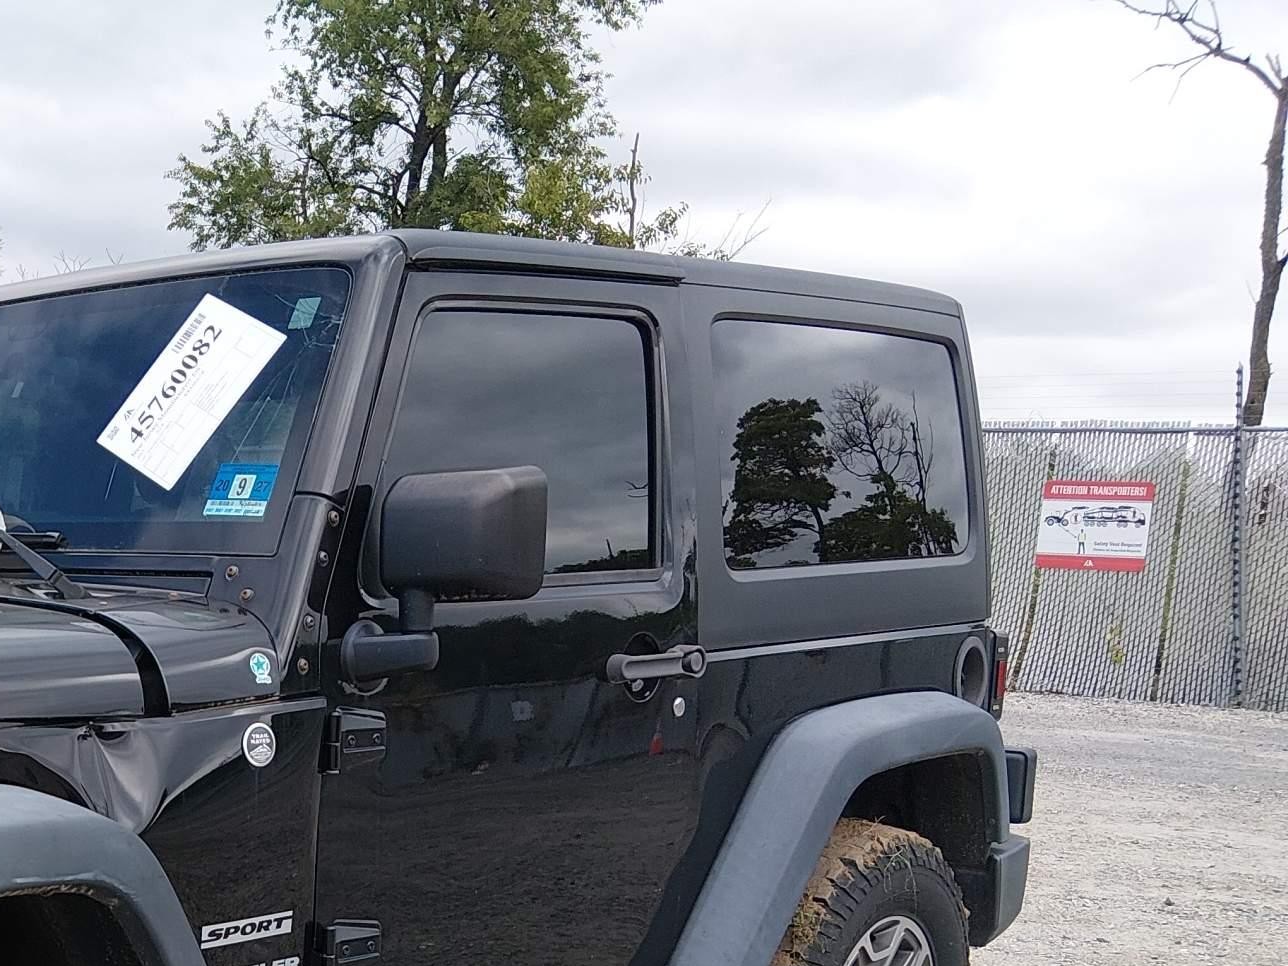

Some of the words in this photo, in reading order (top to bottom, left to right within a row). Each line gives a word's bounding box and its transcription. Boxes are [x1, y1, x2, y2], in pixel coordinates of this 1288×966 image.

[128, 324, 223, 444] 45760082
[236, 477, 248, 496] 9
[1050, 485, 1088, 495] ATTENTION
[1089, 486, 1148, 497] TRANSPORTERS!
[204, 916, 288, 942] SPORT
